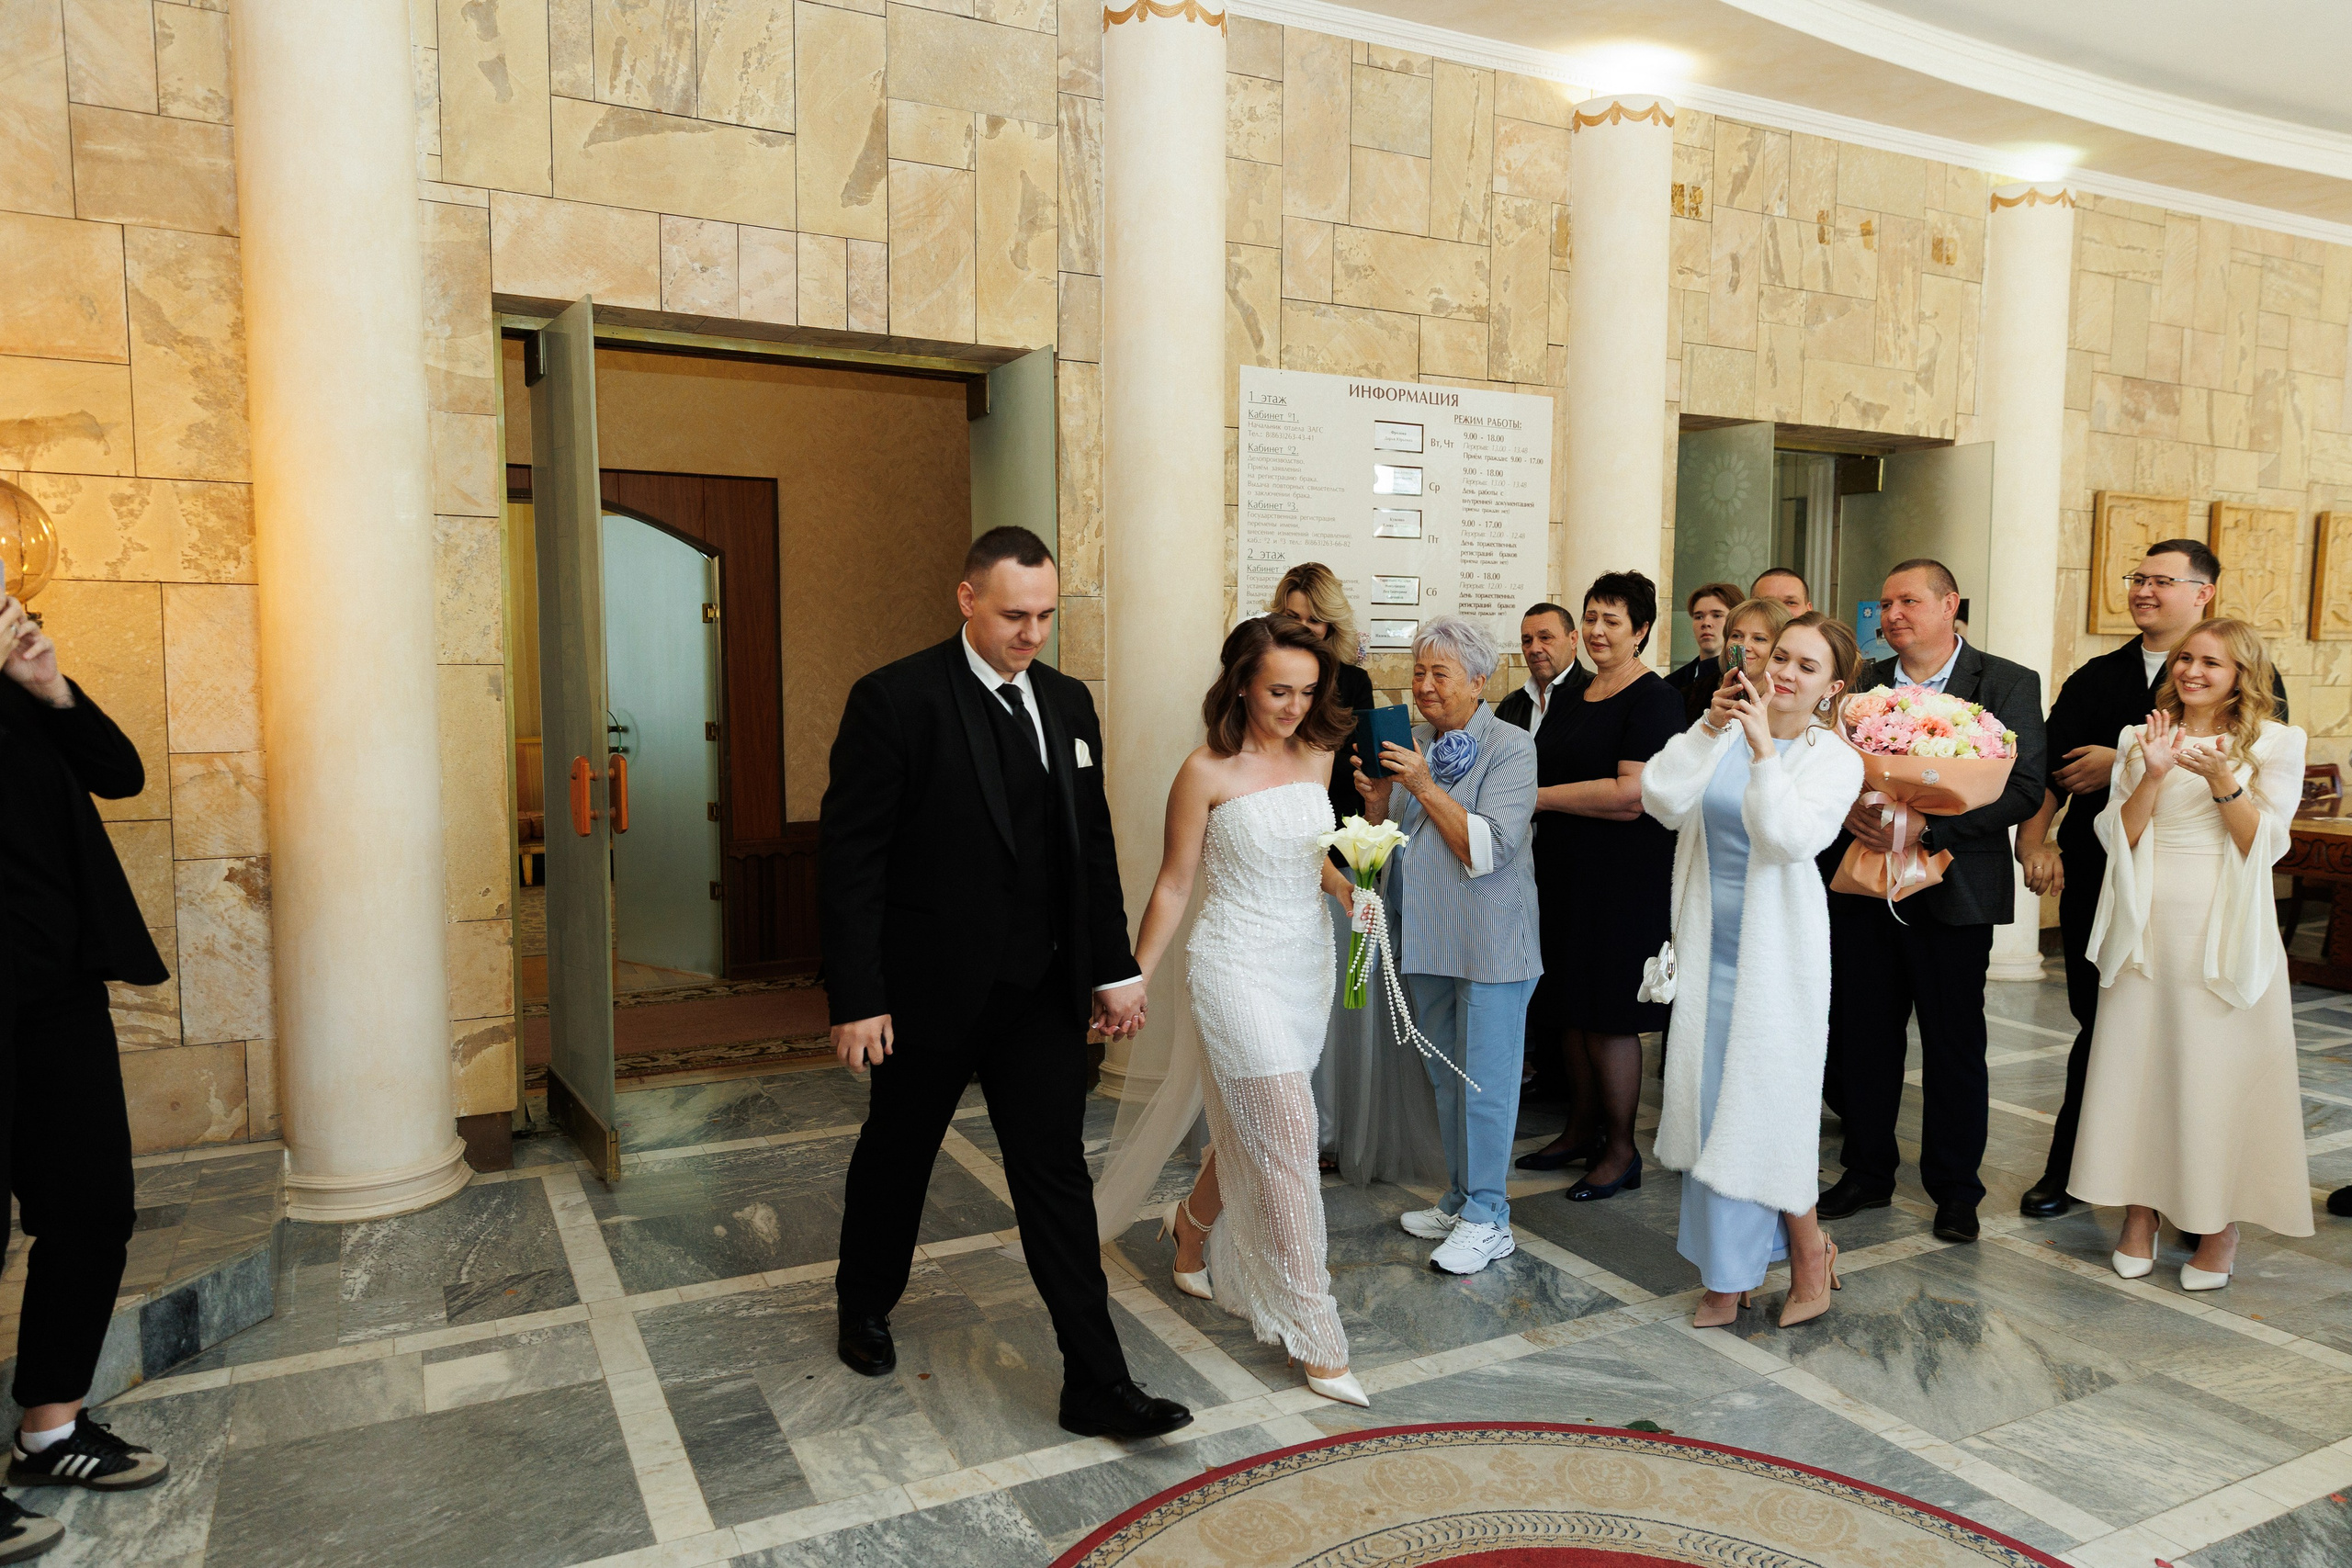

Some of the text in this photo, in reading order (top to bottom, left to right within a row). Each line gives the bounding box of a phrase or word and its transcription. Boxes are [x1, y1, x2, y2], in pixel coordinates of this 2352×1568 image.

[1250, 391, 1286, 404] 1 этаж
[1350, 384, 1458, 407] ИНФОРМАЦИЯ
[1248, 410, 1283, 420] Кабинет
[1248, 422, 1281, 430] Начальник
[1454, 414, 1521, 429] РЕЖИМ РАБОТЫ:
[1464, 432, 1477, 440] 9.00
[1430, 438, 1453, 448] Вт, Чт
[1248, 443, 1283, 453] Кабинет
[1429, 481, 1440, 493] Ср
[1248, 500, 1283, 510] Кабинет
[1495, 500, 1534, 508] документацией
[1247, 512, 1297, 520] Государственная
[1462, 519, 1476, 527] 9.00
[1428, 535, 1439, 544] Пт
[1247, 548, 1285, 559] 2 этаж
[1461, 550, 1517, 559] регистраций браков
[1247, 564, 1279, 573] Кабинет
[1460, 571, 1474, 580] 9.00
[1484, 572, 1500, 581] 18.00
[1426, 587, 1437, 596] Сб
[1459, 602, 1492, 610] регистраций
